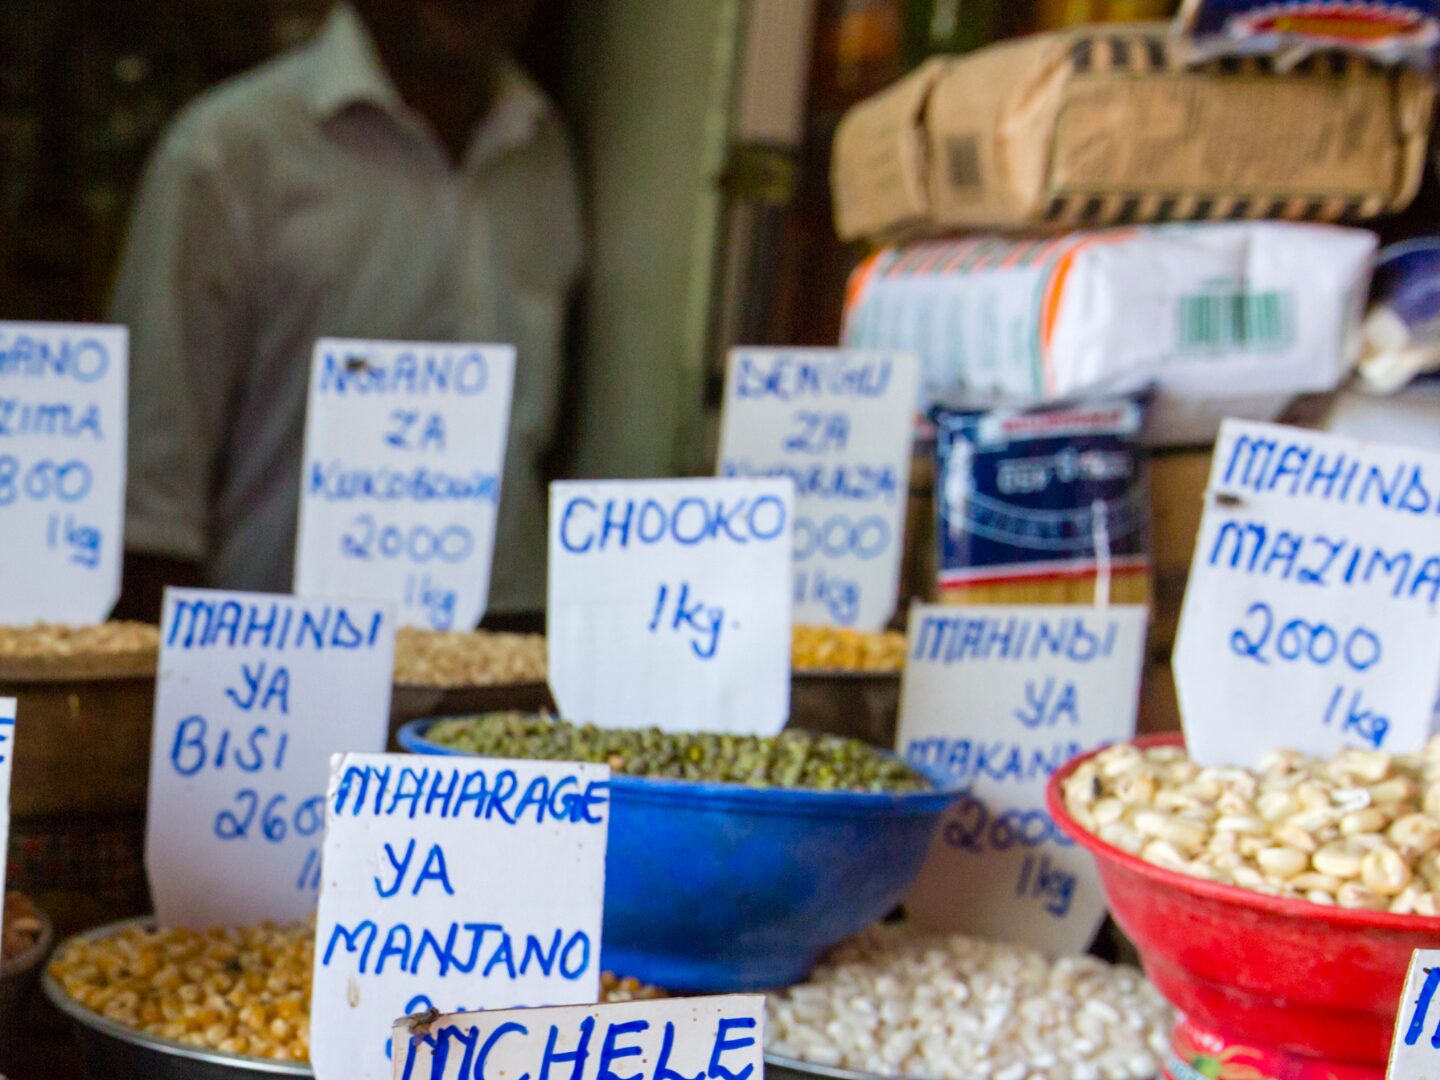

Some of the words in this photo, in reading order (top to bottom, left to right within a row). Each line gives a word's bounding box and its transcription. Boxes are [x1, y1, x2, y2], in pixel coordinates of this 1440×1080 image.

[320, 350, 490, 397] NGANO
[384, 409, 446, 452] ZA
[781, 409, 851, 455] ZA
[340, 513, 475, 565] 2000
[559, 496, 788, 554] CHOOKO
[167, 599, 384, 650] MAHINDI
[914, 616, 1118, 663] MAHINDI
[1229, 601, 1383, 672] 2000
[223, 660, 290, 716] YA
[1013, 677, 1080, 728] YA
[170, 714, 289, 778] BISI
[333, 764, 610, 825] MAHARAGE
[373, 838, 456, 898] YA
[322, 919, 592, 981] MANJANO
